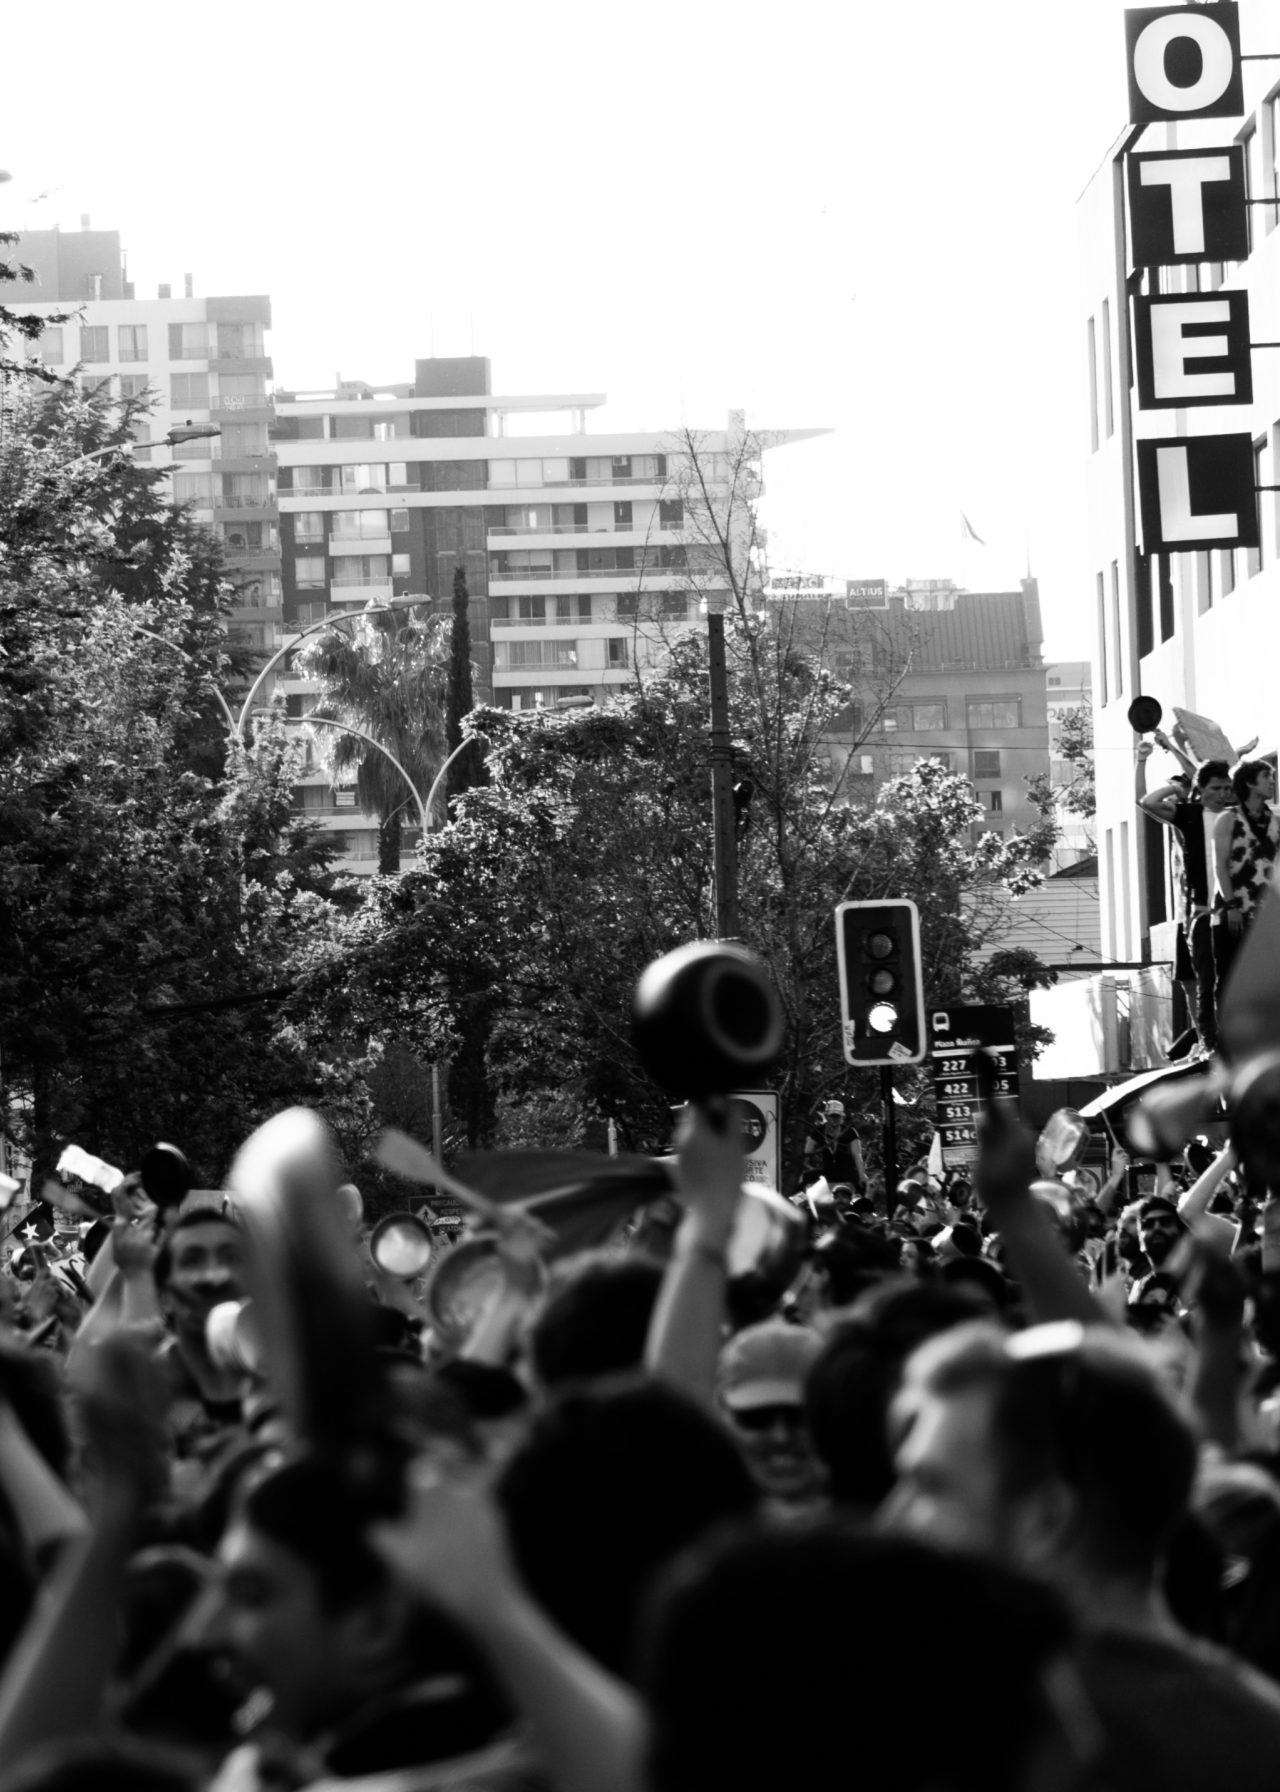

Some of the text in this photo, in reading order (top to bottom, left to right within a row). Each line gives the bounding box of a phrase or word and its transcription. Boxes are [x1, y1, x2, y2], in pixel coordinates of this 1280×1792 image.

[1133, 12, 1239, 542] OTEL
[849, 588, 883, 597] ALTIUS
[942, 1060, 966, 1071] 227
[944, 1083, 968, 1094] 422
[946, 1106, 971, 1118] 513
